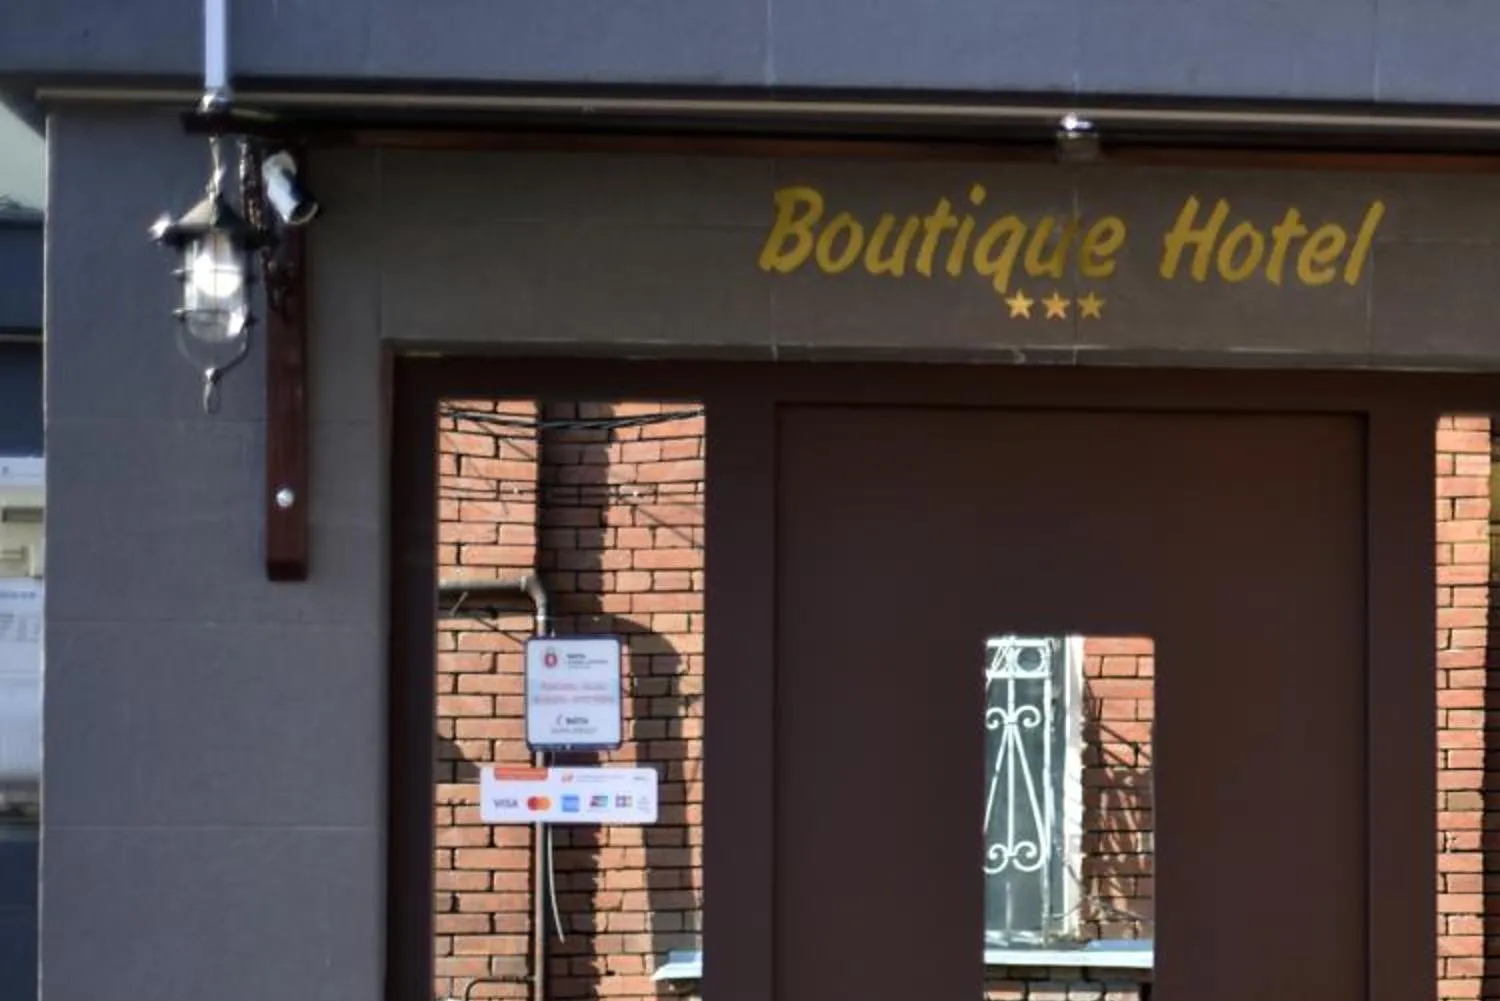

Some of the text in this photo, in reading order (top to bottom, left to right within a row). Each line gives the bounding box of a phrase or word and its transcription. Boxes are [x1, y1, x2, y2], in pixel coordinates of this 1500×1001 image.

[758, 184, 1386, 292] Boutique Hotel
[492, 799, 518, 808] VISA
